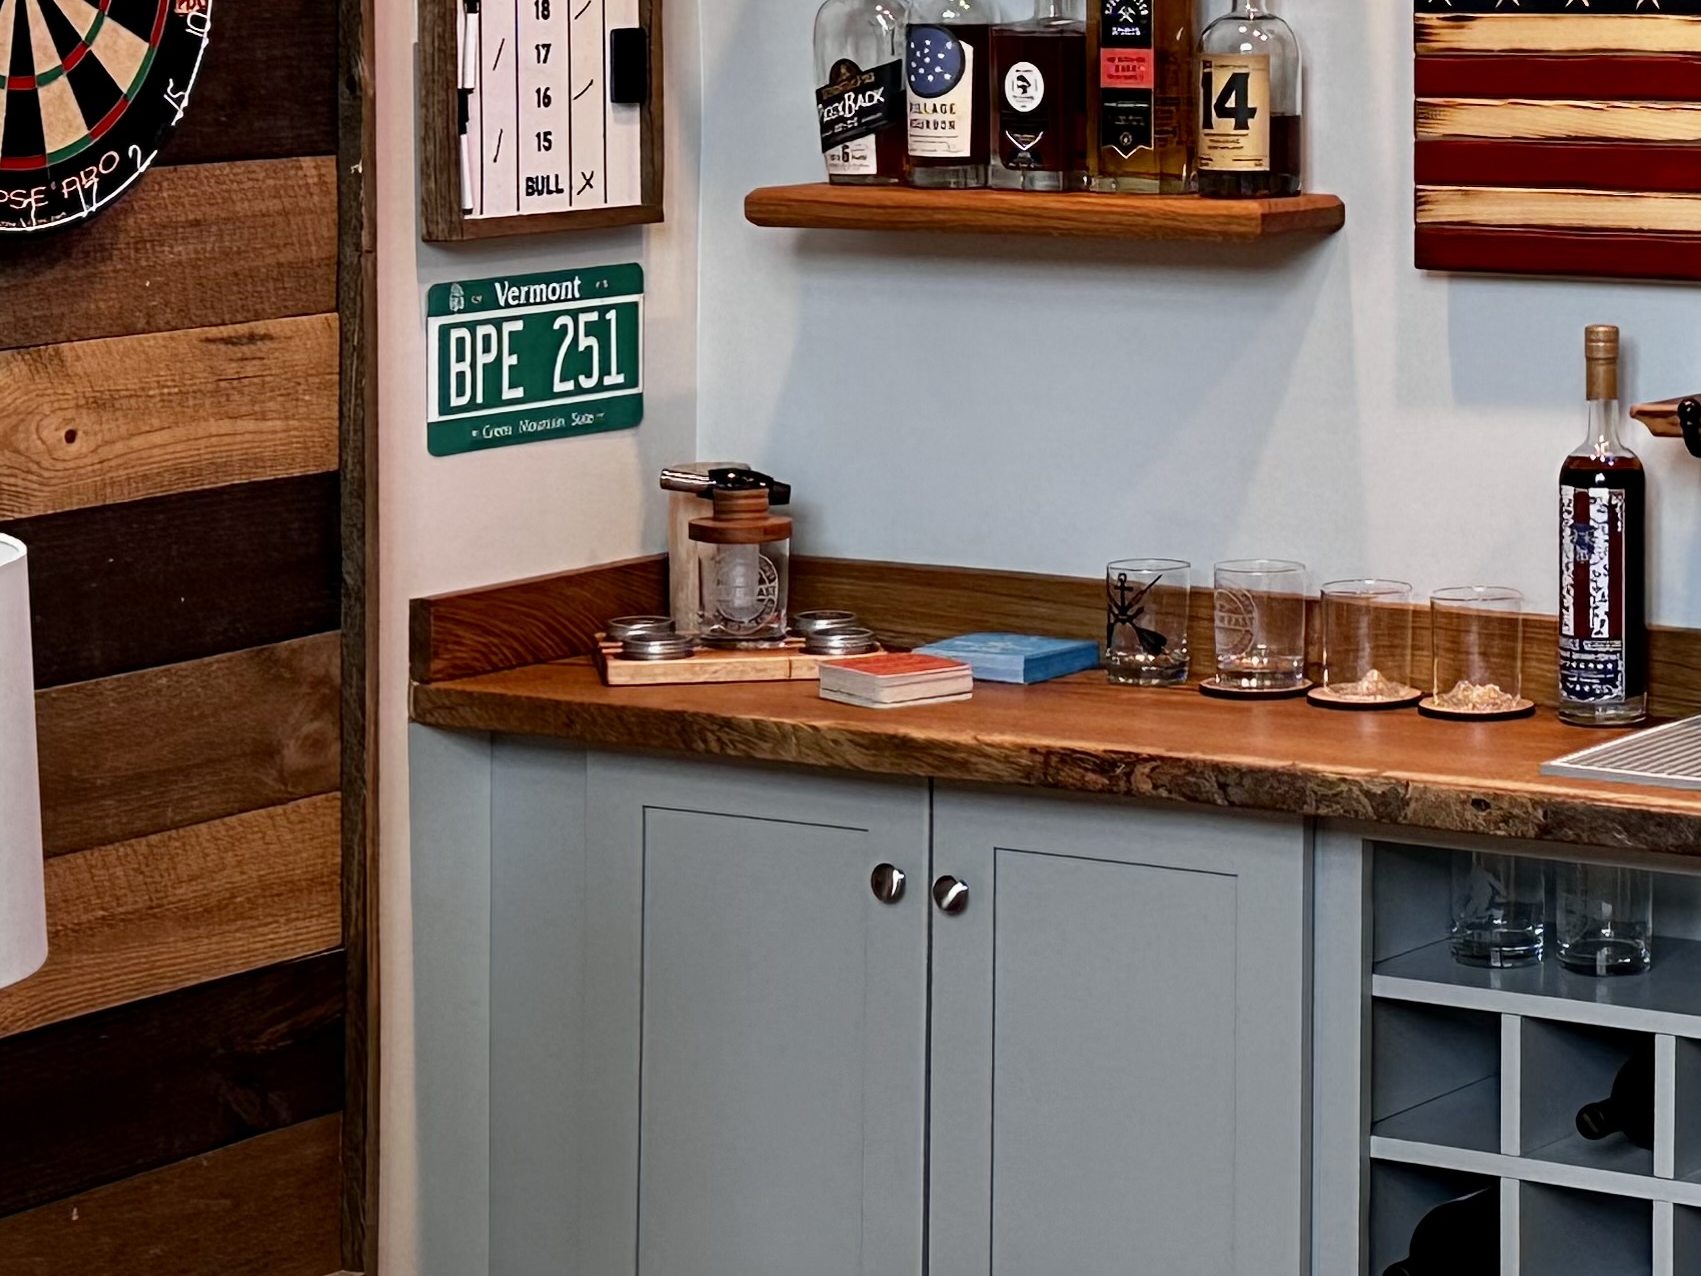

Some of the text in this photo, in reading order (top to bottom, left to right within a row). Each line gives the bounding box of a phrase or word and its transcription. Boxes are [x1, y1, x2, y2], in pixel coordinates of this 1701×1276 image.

[534, 0, 550, 20] 18
[535, 43, 552, 64] 17
[535, 87, 552, 108] 16
[1202, 72, 1258, 131] 14
[535, 131, 552, 152] 15
[525, 174, 565, 196] BULL
[494, 275, 582, 307] Vermont
[450, 308, 625, 407] BPE 251
